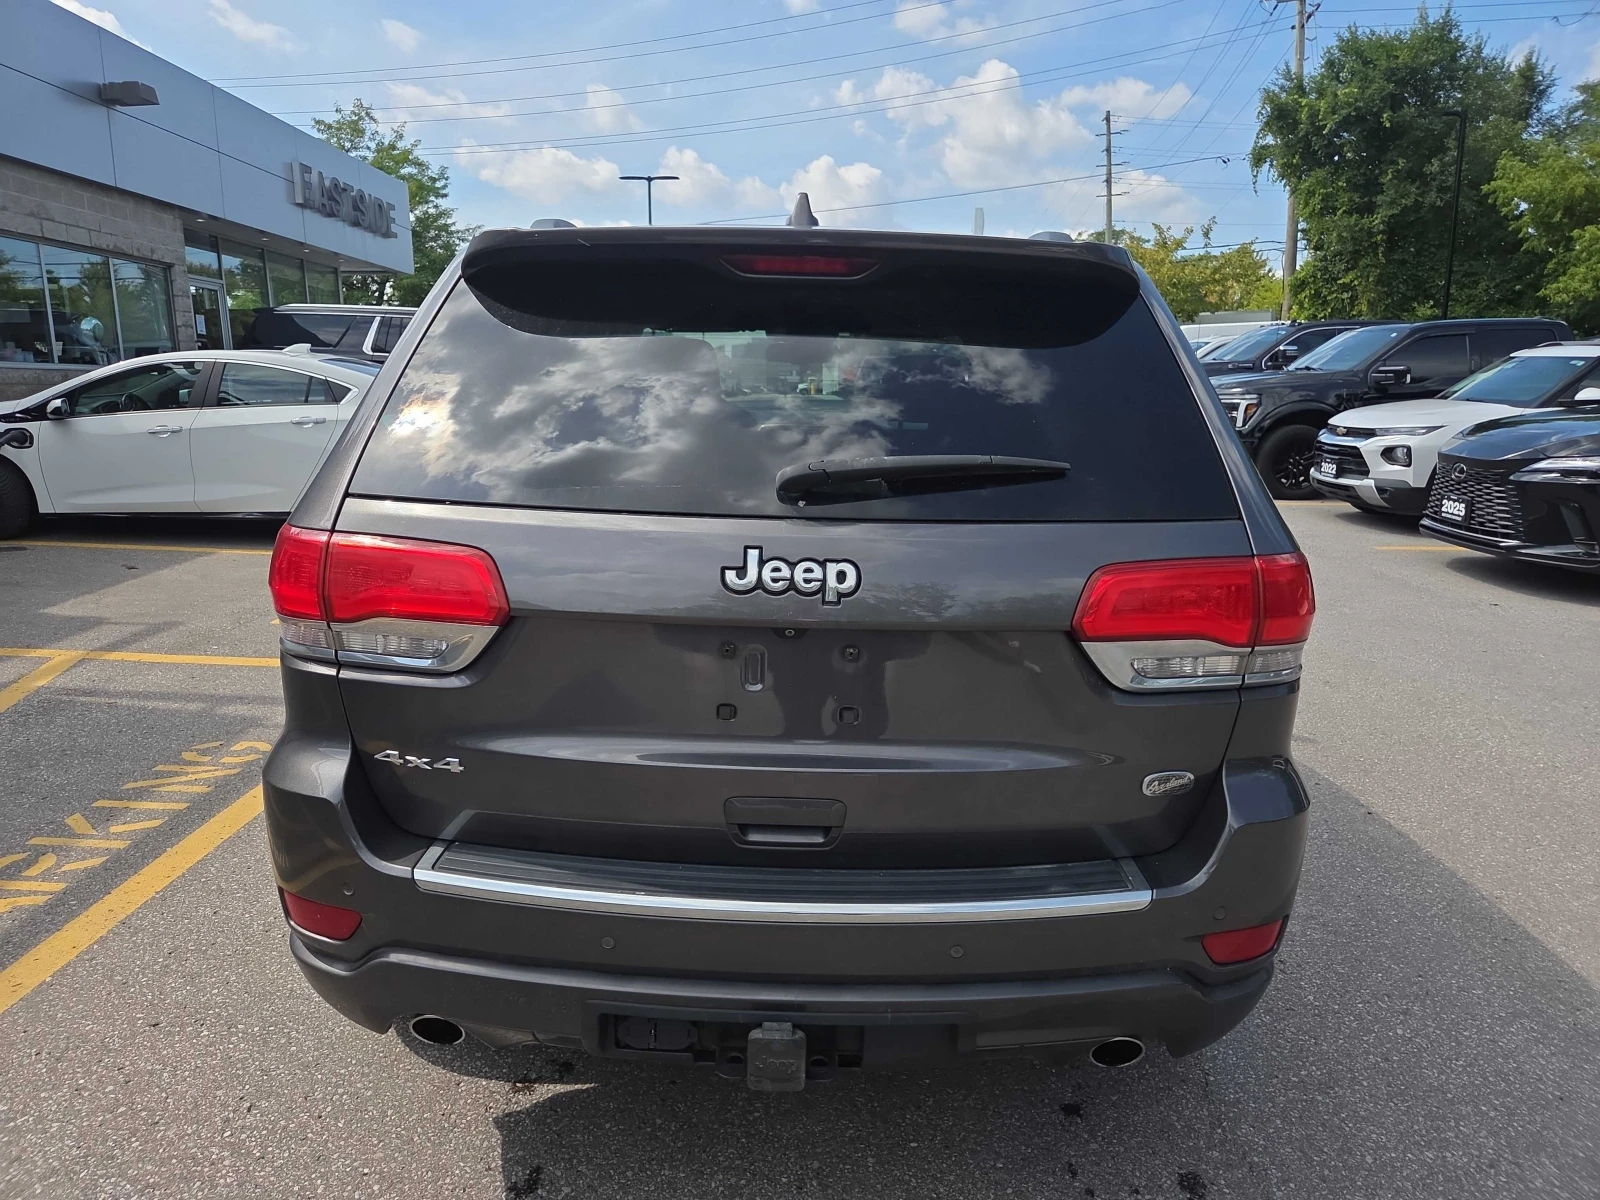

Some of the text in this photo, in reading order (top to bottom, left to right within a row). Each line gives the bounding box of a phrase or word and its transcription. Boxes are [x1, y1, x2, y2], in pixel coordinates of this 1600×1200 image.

[292, 161, 397, 239] EASTSIDE
[1320, 462, 1336, 474] 2022
[1441, 499, 1466, 517] 2025
[721, 546, 861, 605] Jeep
